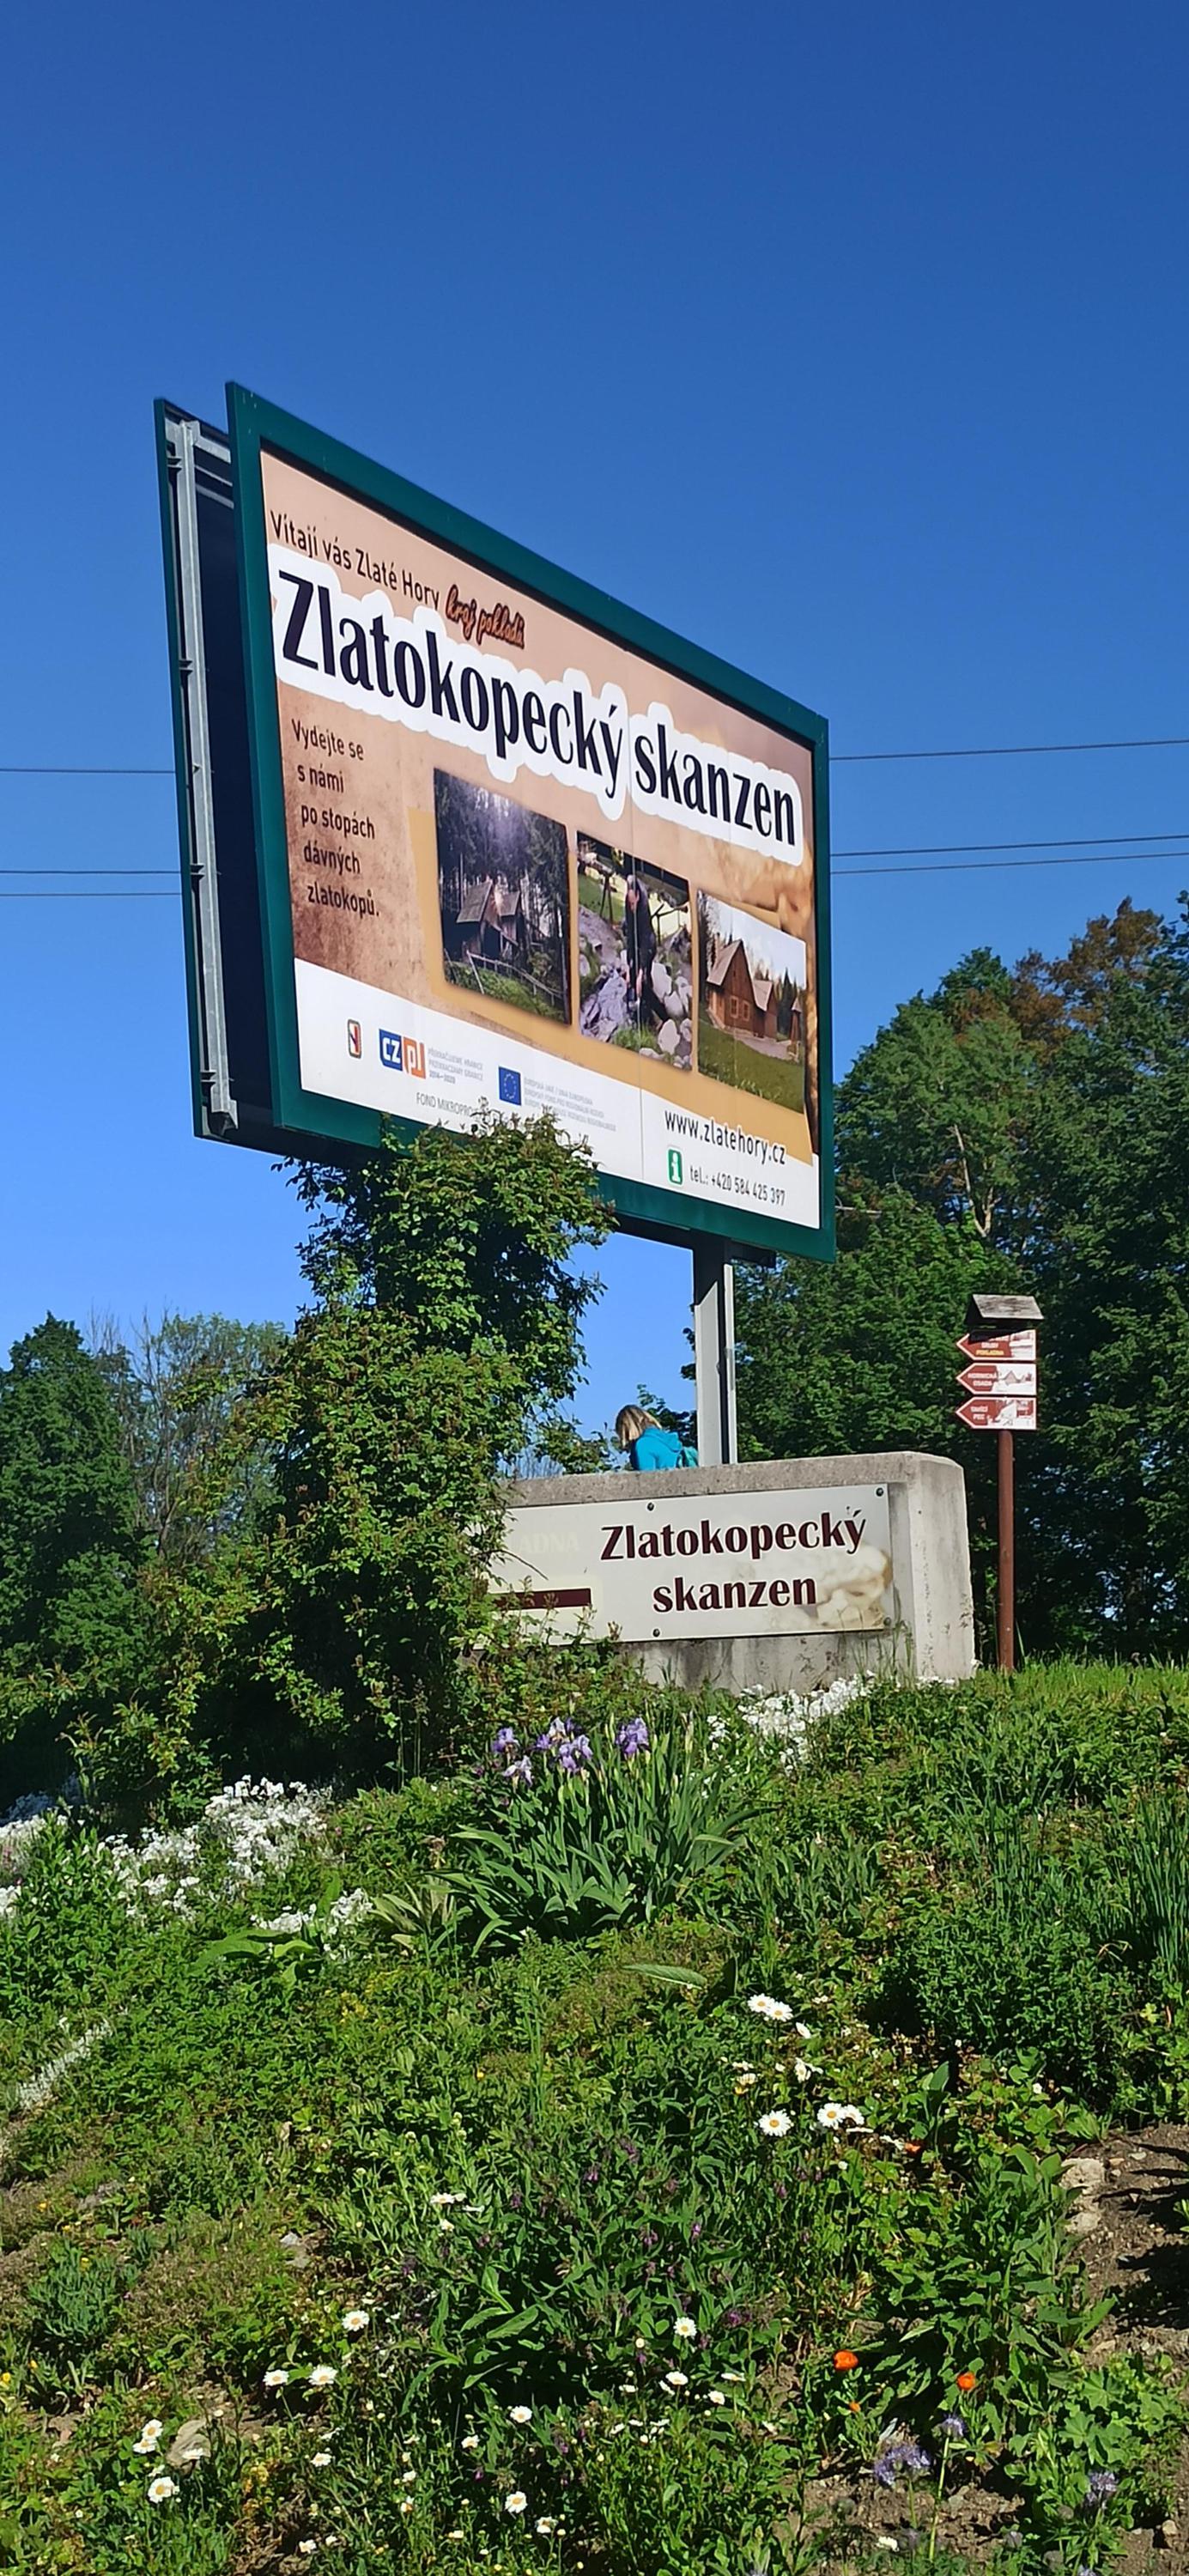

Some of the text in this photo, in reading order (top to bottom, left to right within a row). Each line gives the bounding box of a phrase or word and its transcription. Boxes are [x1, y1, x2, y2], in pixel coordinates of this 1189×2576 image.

[270, 510, 318, 556] Vítají
[323, 537, 351, 569] vás
[355, 549, 397, 590] Zlaté
[402, 570, 440, 610] Hory
[279, 569, 795, 847] Zlatokopecký skanzen
[291, 719, 364, 761] Vydejte se
[297, 762, 343, 793] s námi
[301, 805, 375, 839] po stopách
[303, 840, 361, 876] dávných
[306, 882, 379, 917] zlatokopů.
[416, 1092, 436, 1108] FOND
[664, 1110, 786, 1165] www.zlatehory.cz
[689, 1165, 786, 1206] tel.: +420 584 425 397
[600, 1510, 866, 1560] Zlatokopecký
[652, 1577, 816, 1613] skanzen
